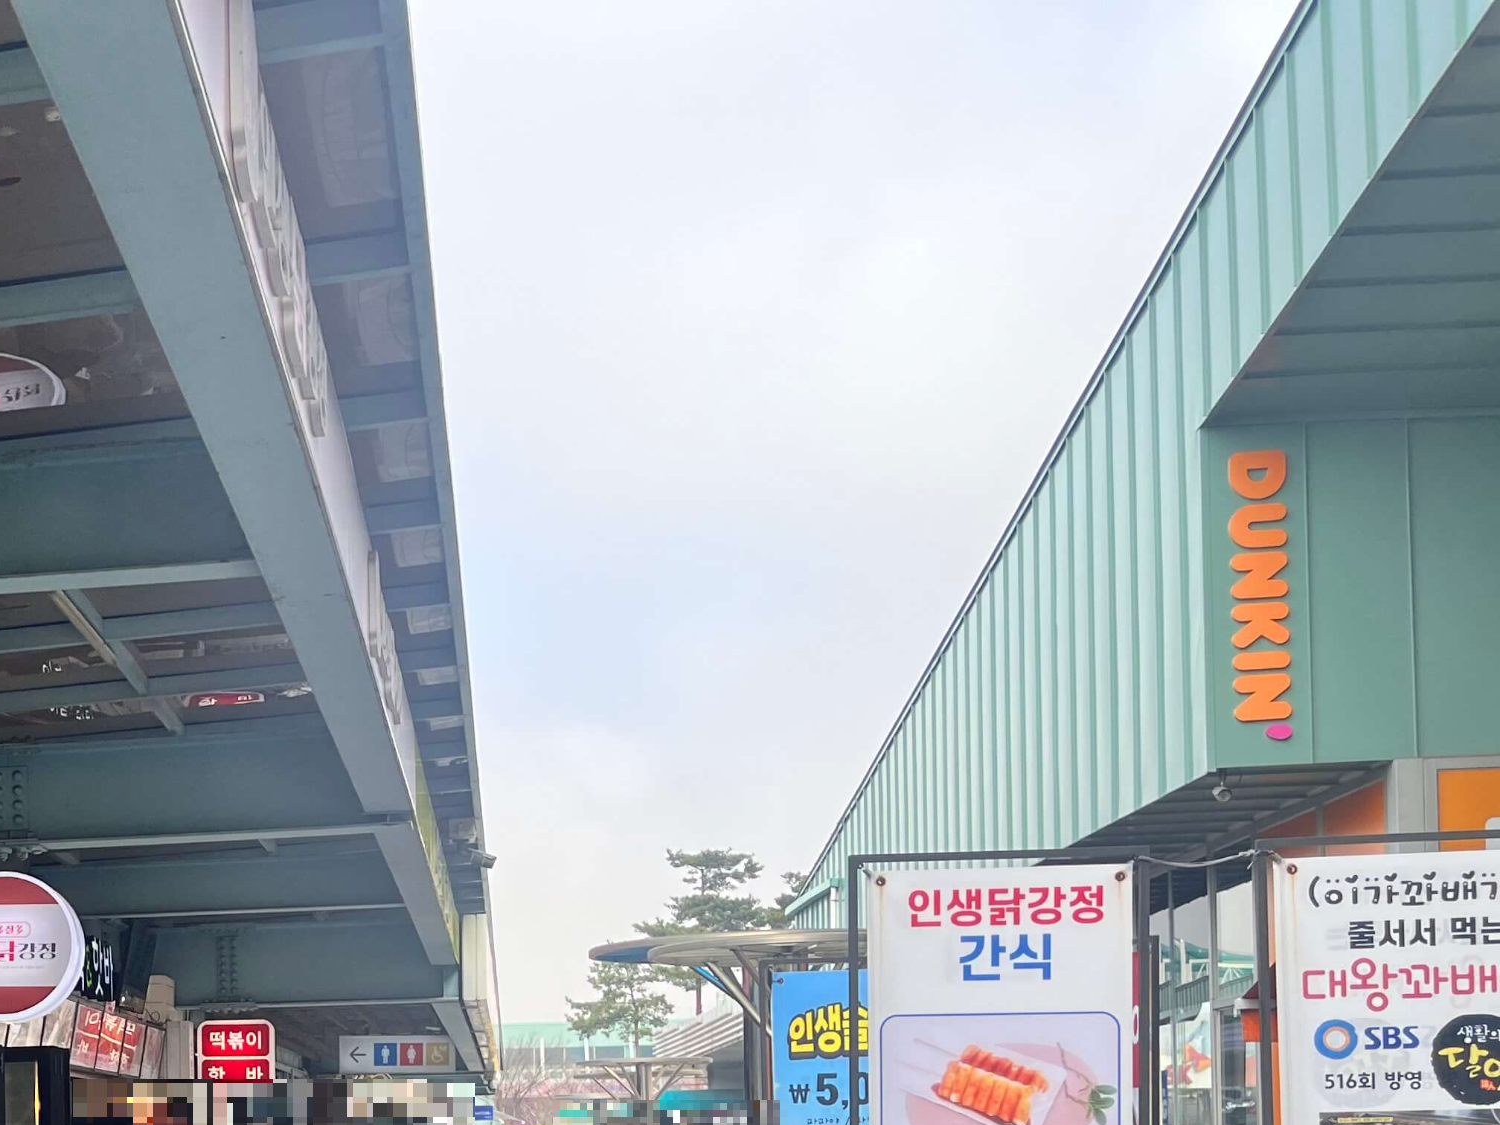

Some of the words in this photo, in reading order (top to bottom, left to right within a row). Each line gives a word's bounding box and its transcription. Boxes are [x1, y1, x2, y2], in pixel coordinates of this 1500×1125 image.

[907, 885, 1105, 928] 인생닭강정
[1348, 917, 1436, 949] 줄서서
[959, 933, 1052, 981] 간식
[209, 1031, 262, 1051] 떡볶이
[1364, 1025, 1420, 1050] SBS
[1457, 1024, 1500, 1044] 생활의
[1325, 1071, 1375, 1090] 516회
[1385, 1071, 1422, 1091] 방영
